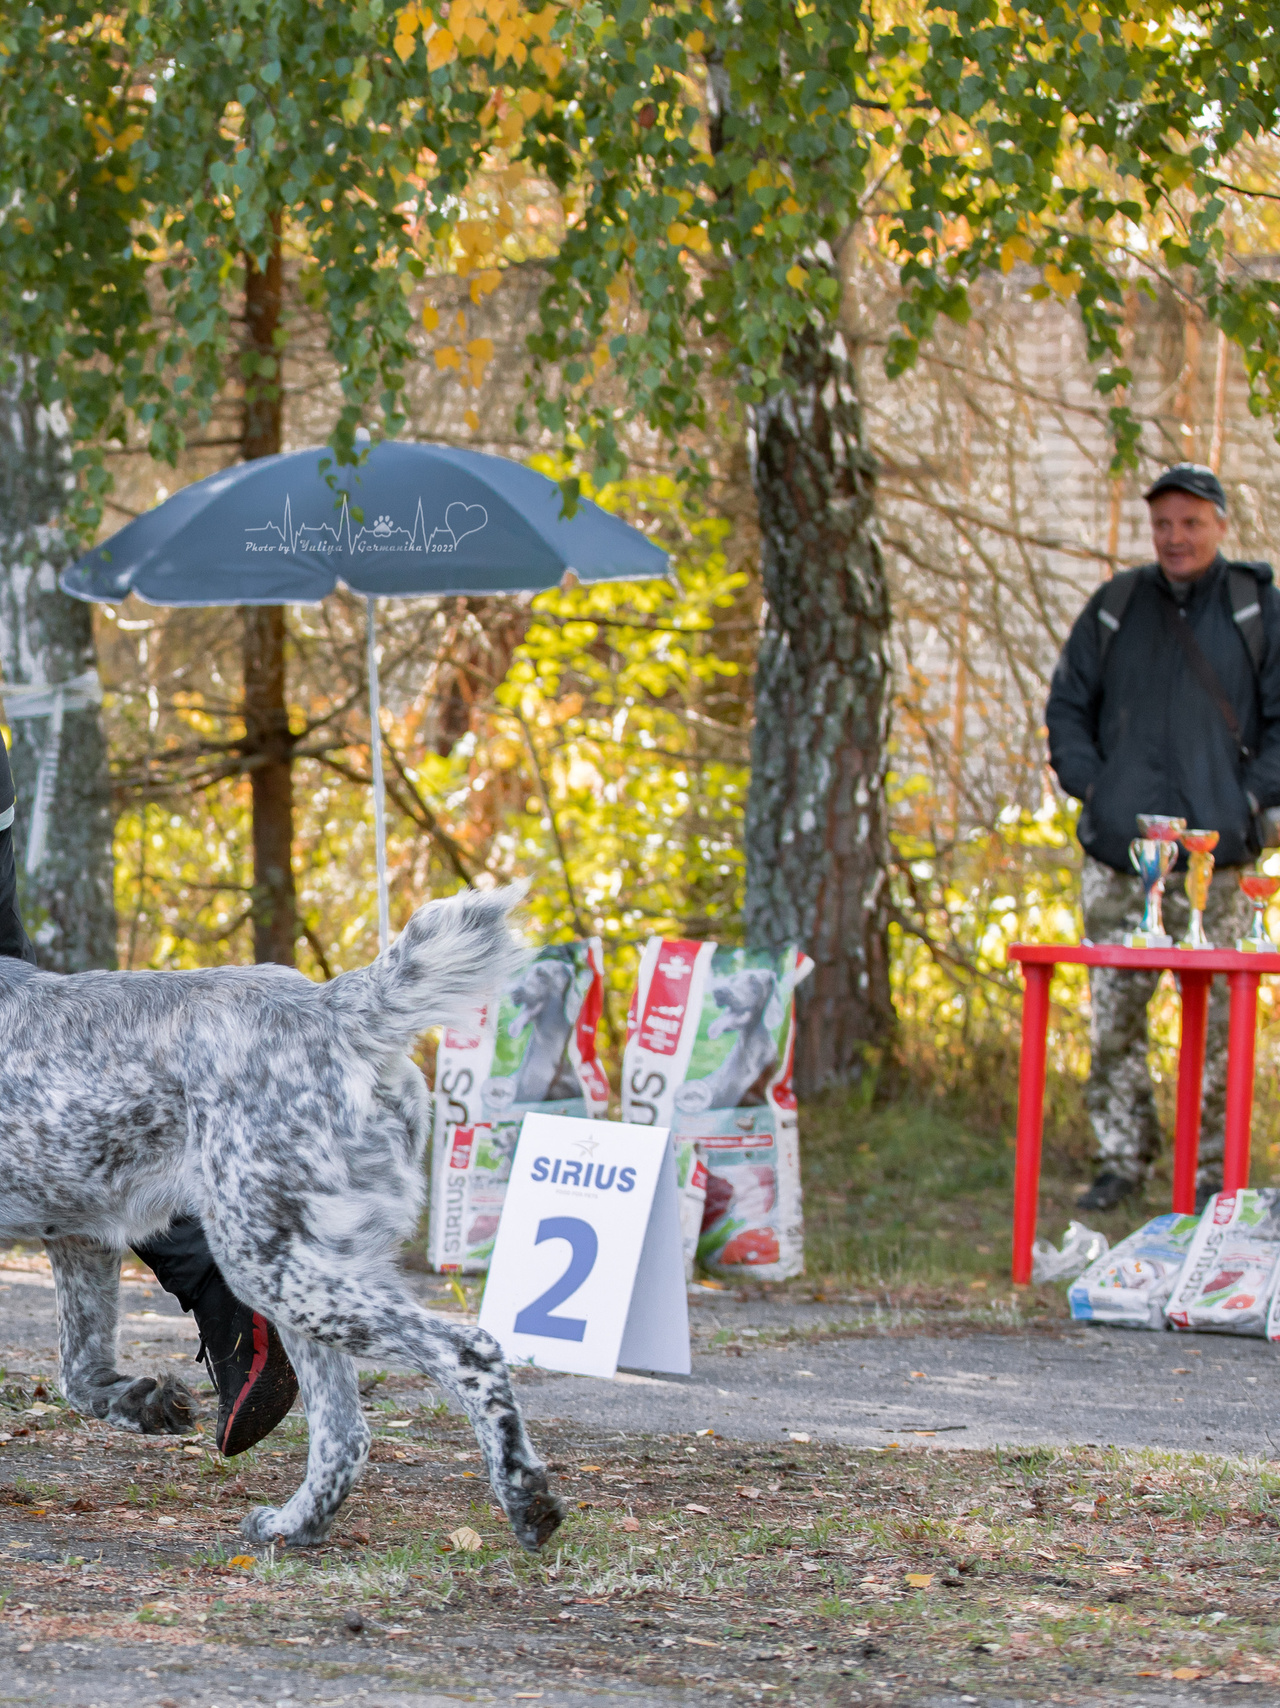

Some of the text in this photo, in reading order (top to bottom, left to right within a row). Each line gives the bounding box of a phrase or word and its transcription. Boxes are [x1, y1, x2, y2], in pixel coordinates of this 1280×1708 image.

[443, 1174, 467, 1254] SIRIUS
[531, 1156, 637, 1193] SIRIUS
[514, 1216, 598, 1342] 2
